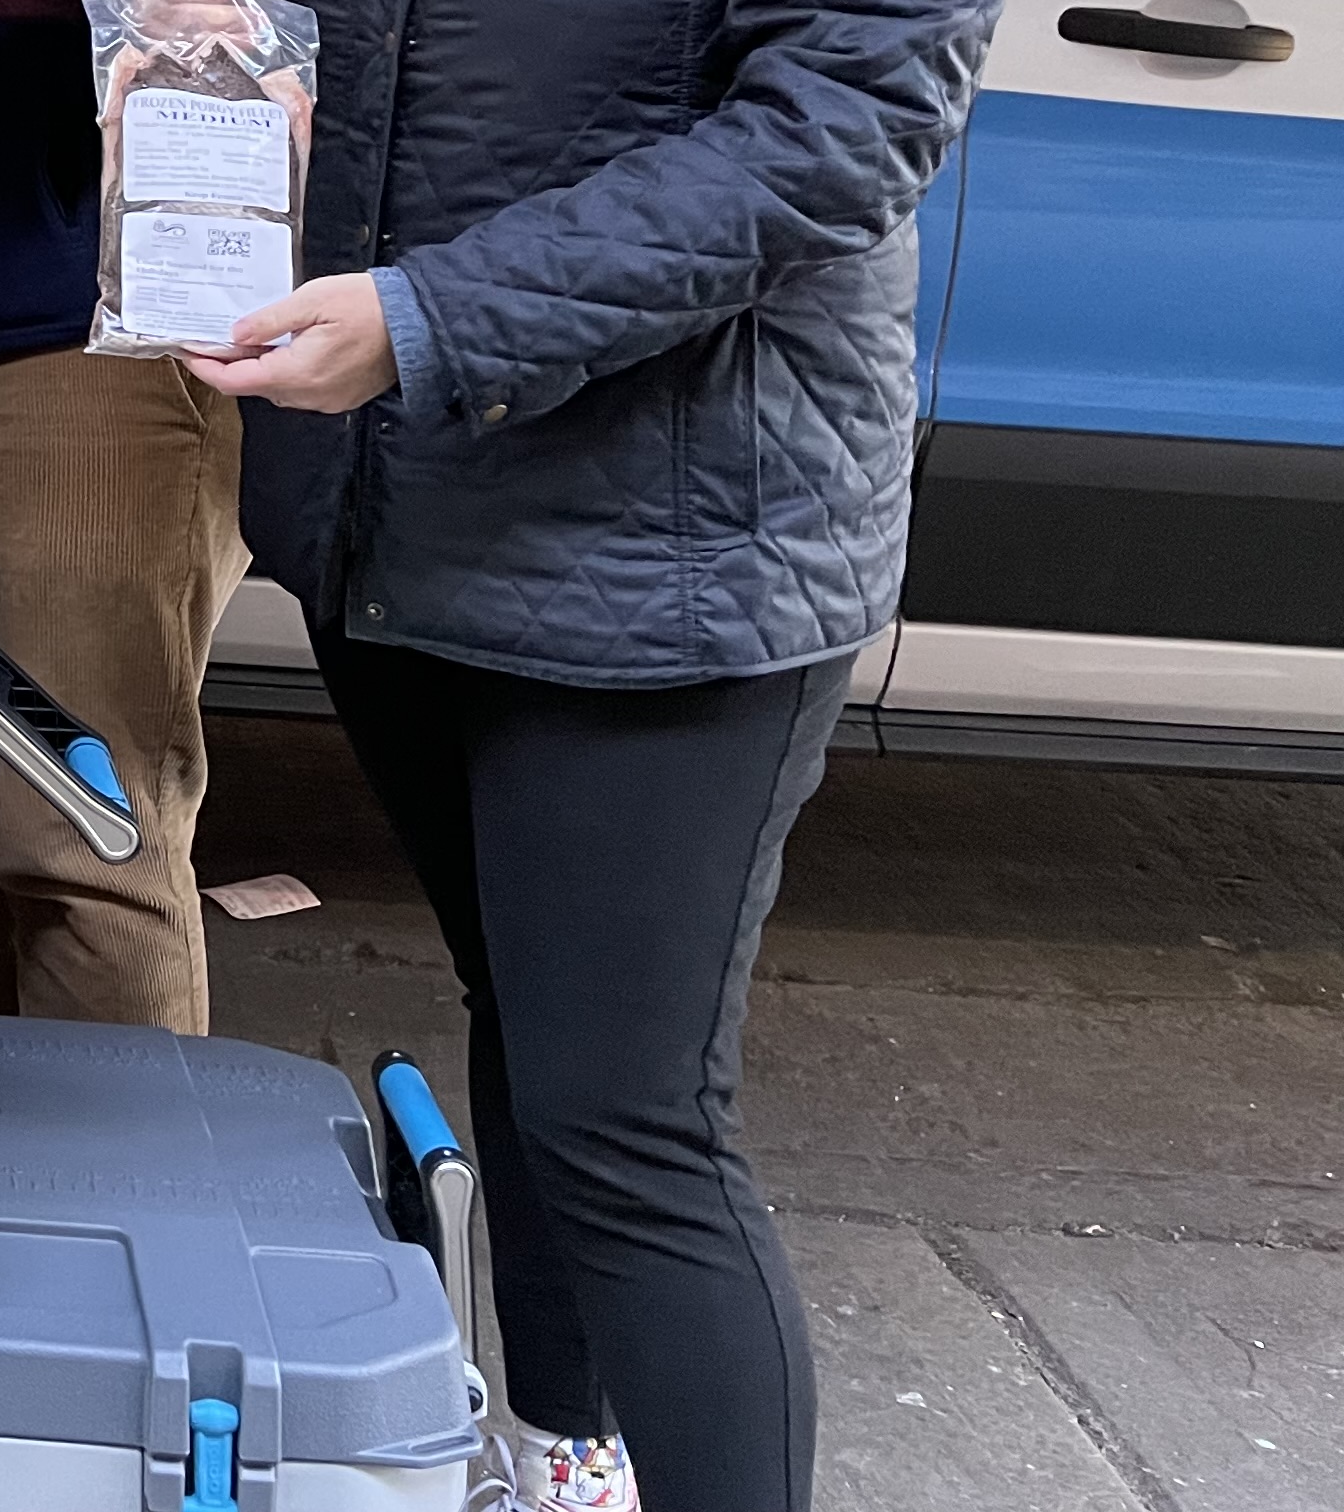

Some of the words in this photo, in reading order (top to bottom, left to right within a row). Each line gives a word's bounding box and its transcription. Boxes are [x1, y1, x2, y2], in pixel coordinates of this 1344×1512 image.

[132, 96, 187, 109] FROZEN
[190, 99, 234, 116] PORGY
[156, 110, 271, 128] MEDIUM
